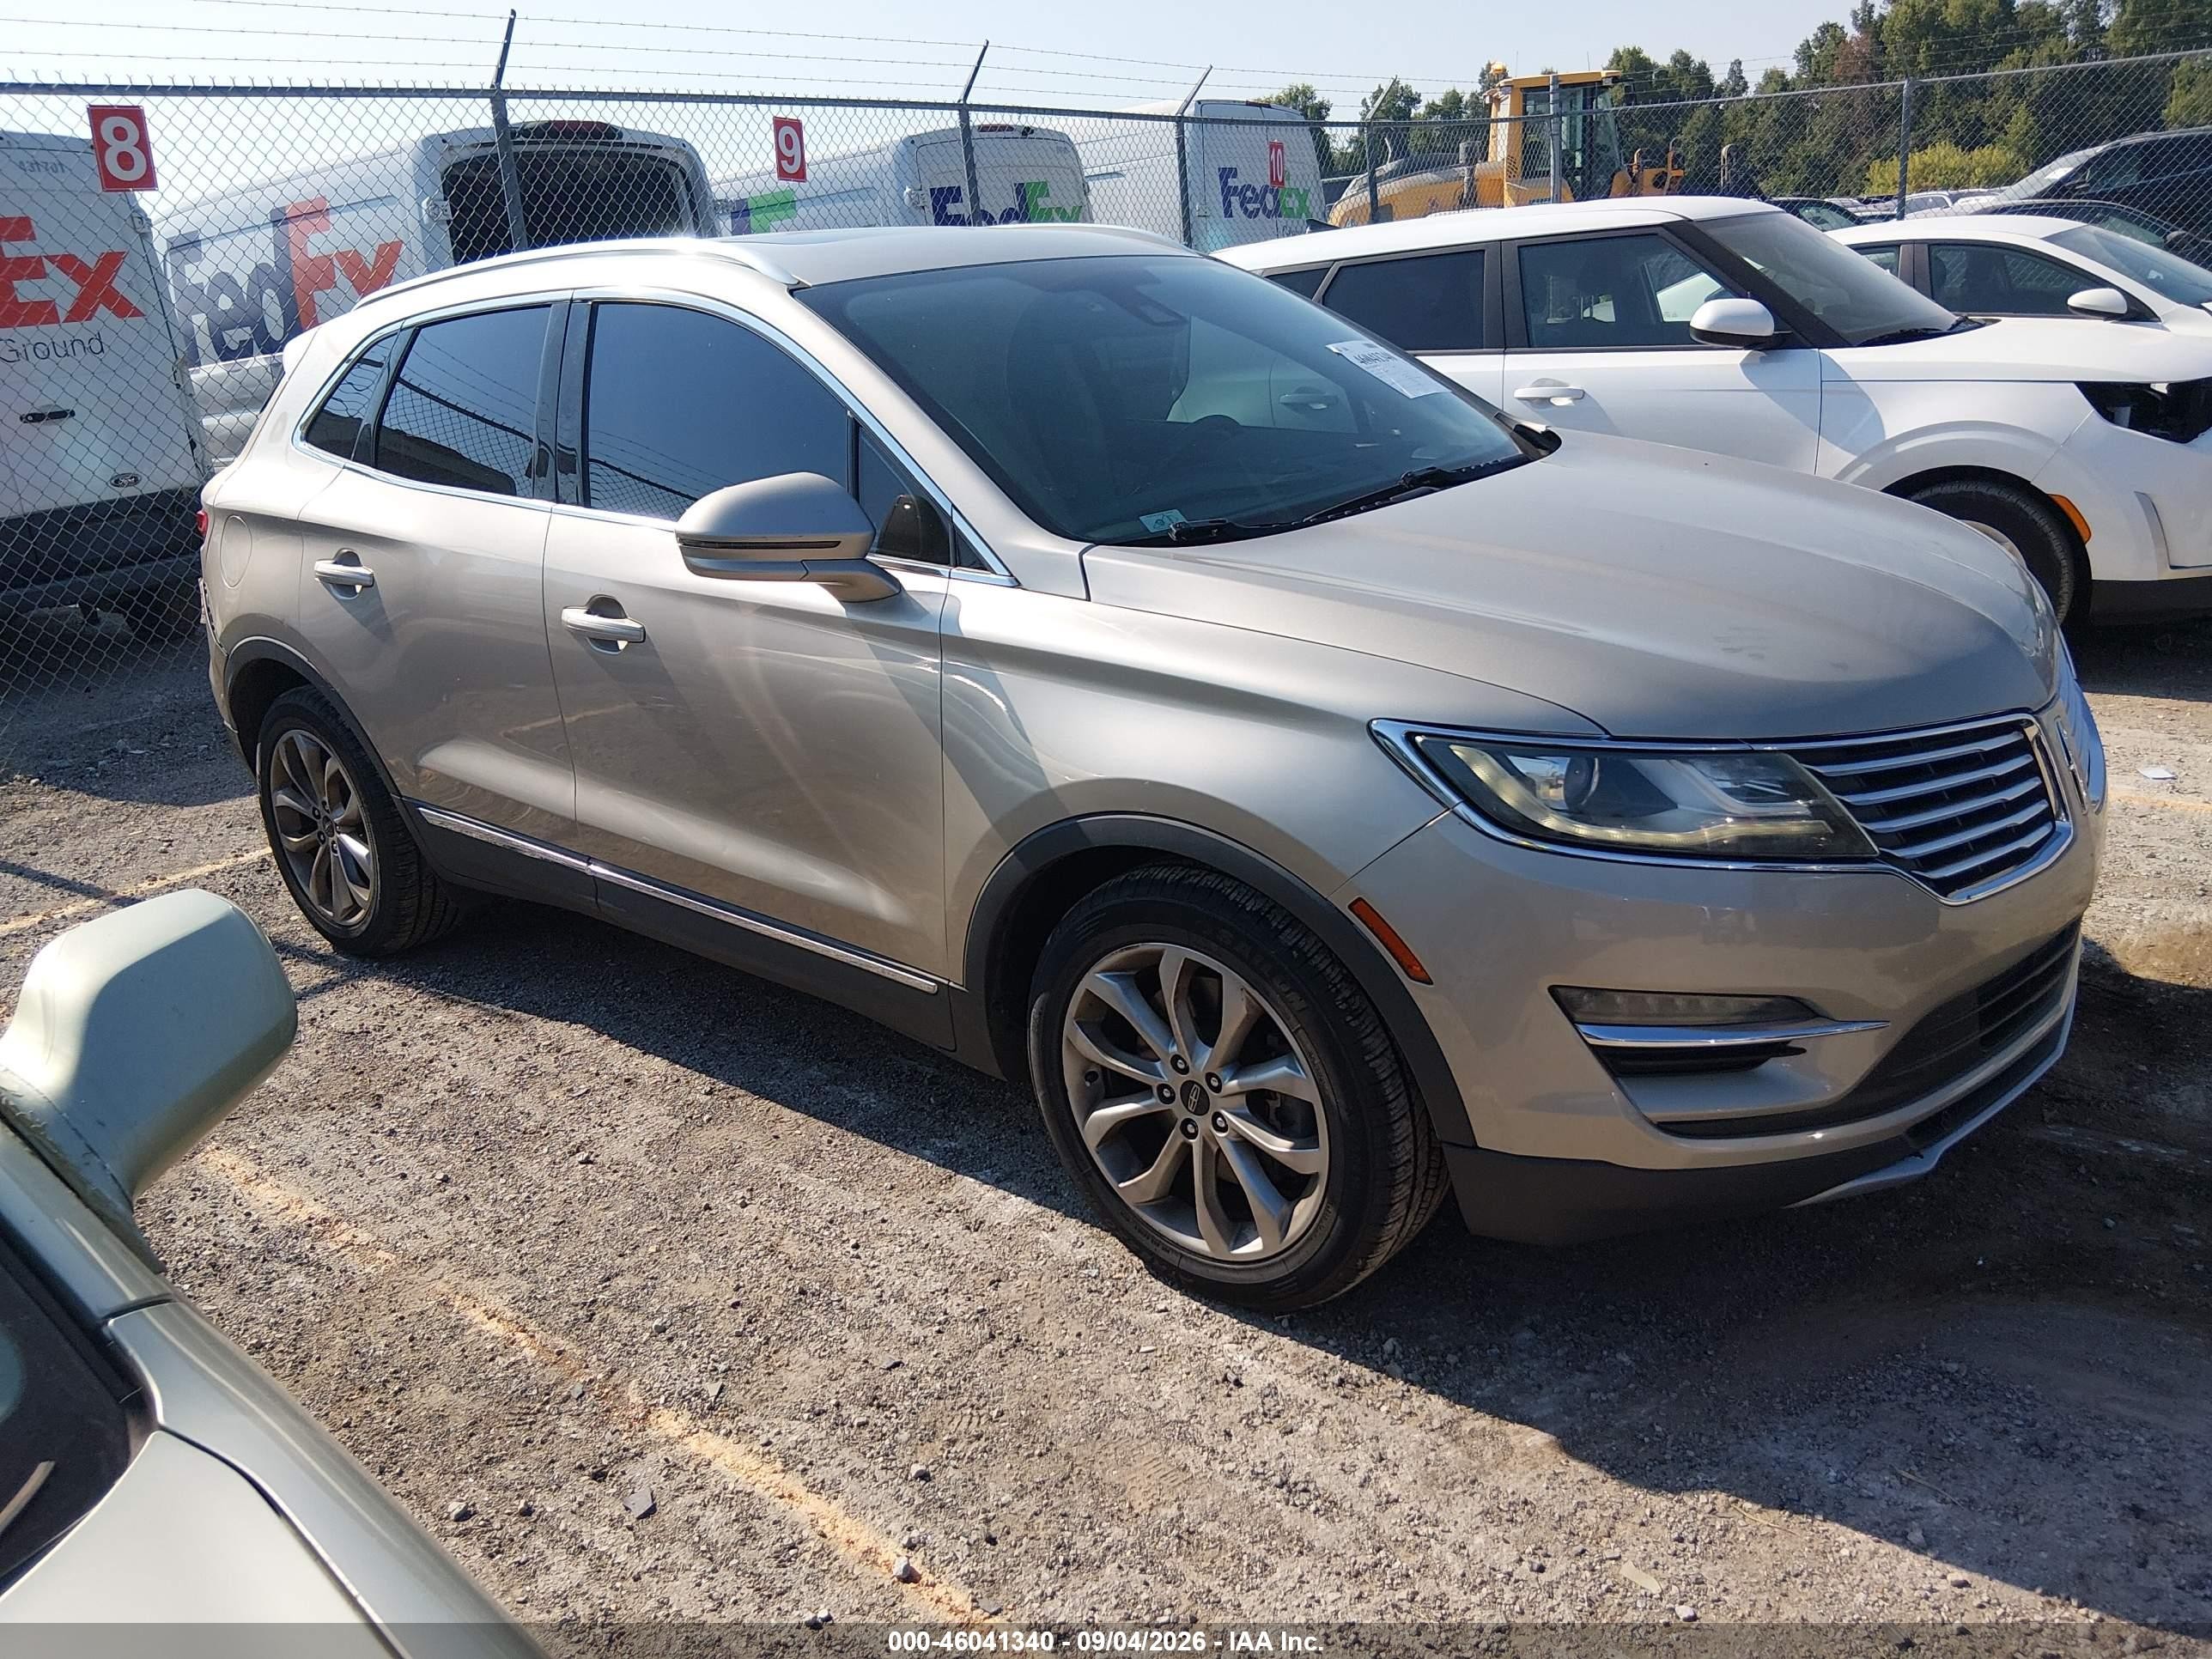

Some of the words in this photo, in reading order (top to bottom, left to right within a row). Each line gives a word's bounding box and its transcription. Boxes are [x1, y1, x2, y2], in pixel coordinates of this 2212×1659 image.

[100, 115, 148, 181] 8
[778, 125, 802, 174] 9
[1270, 148, 1284, 183] 10
[1218, 167, 1311, 220] FedEx
